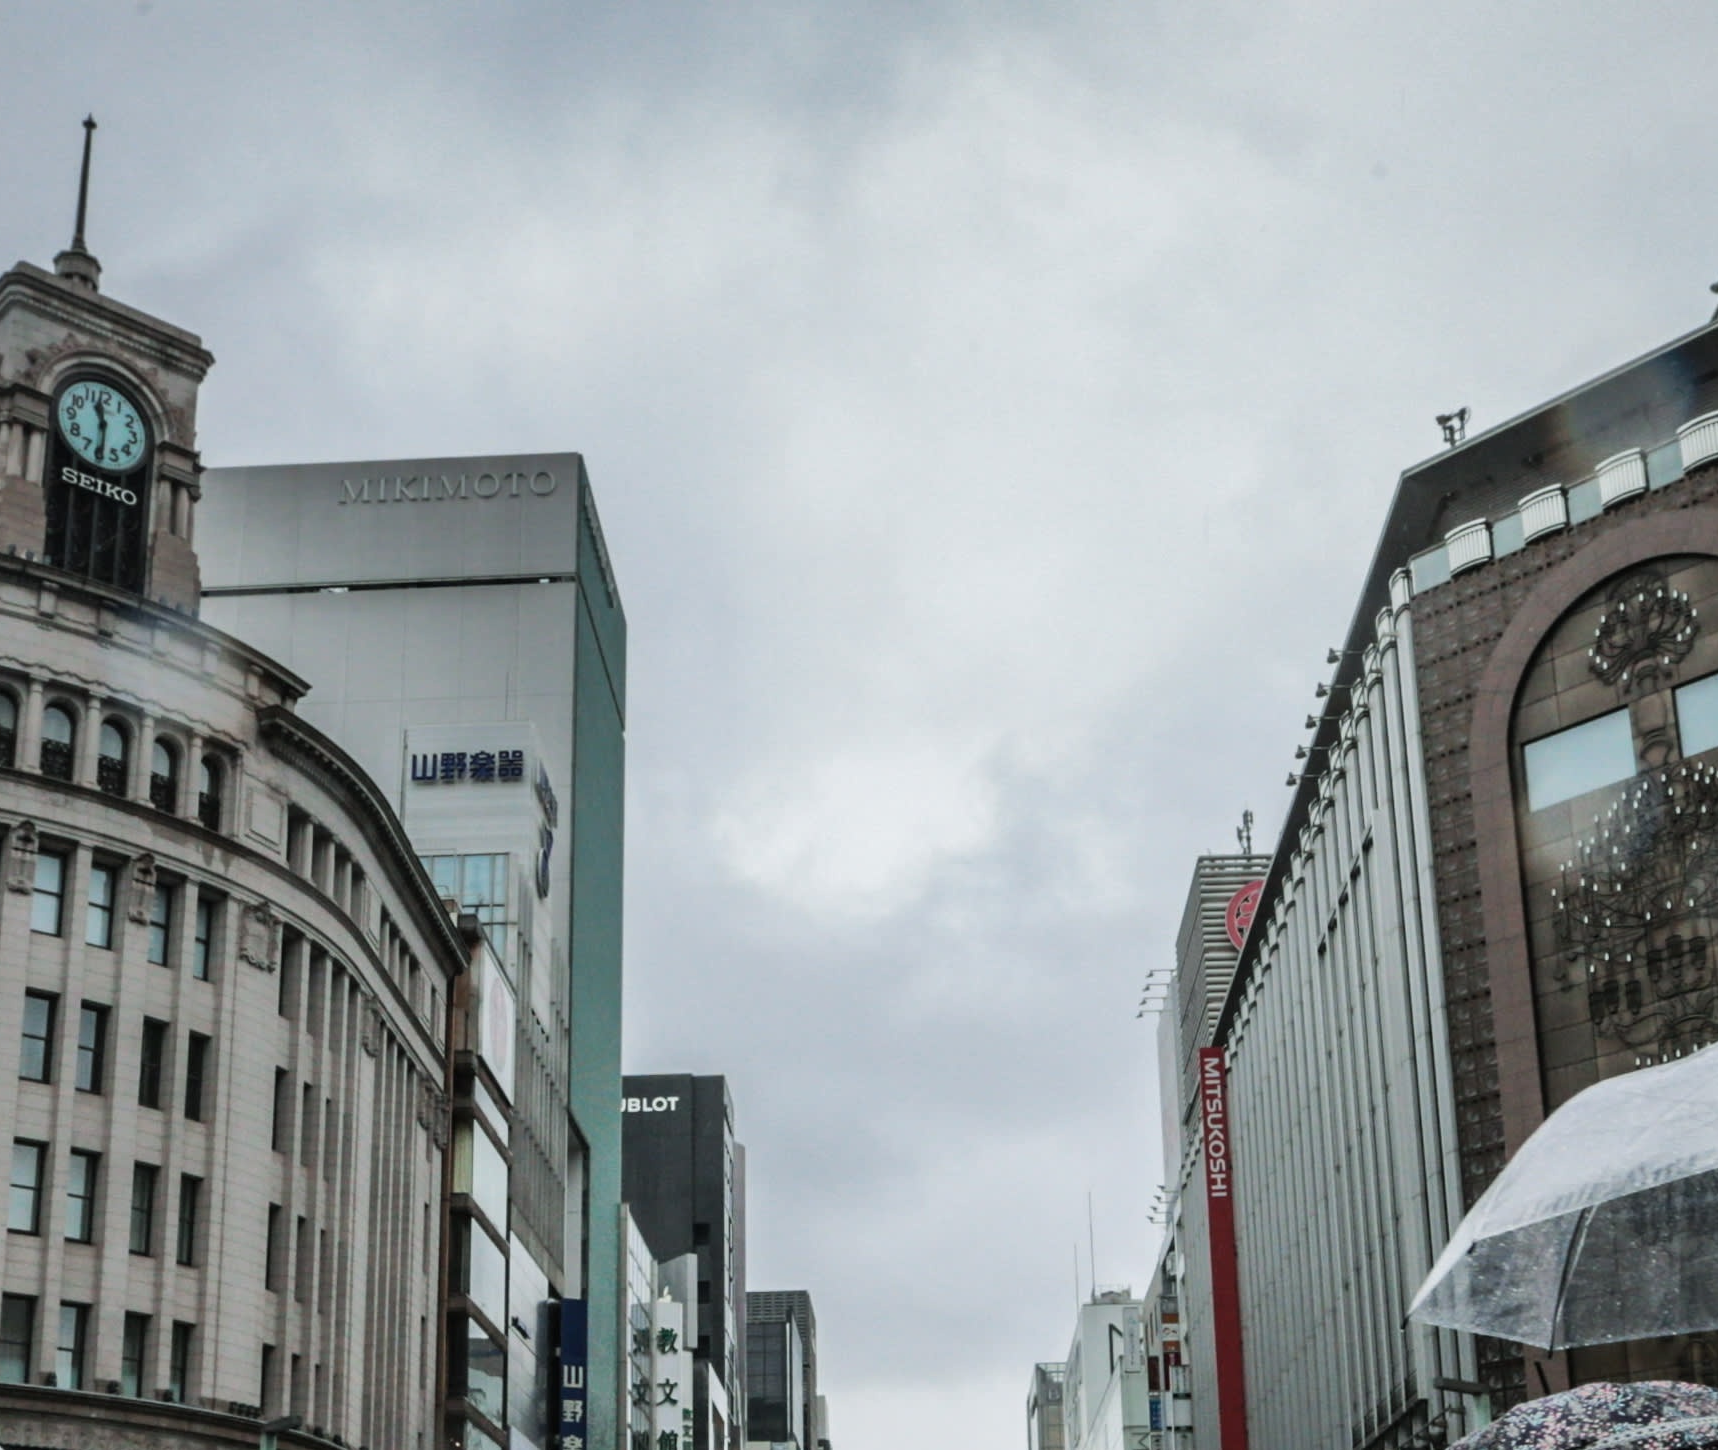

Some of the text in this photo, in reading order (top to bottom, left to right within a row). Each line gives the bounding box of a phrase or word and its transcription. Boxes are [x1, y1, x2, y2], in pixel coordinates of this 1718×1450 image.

[61, 466, 137, 505] SEIKO
[337, 470, 559, 507] MIKIMOTO
[410, 749, 524, 782] 山野楽器
[1202, 1056, 1228, 1200] MITSUKOSHI
